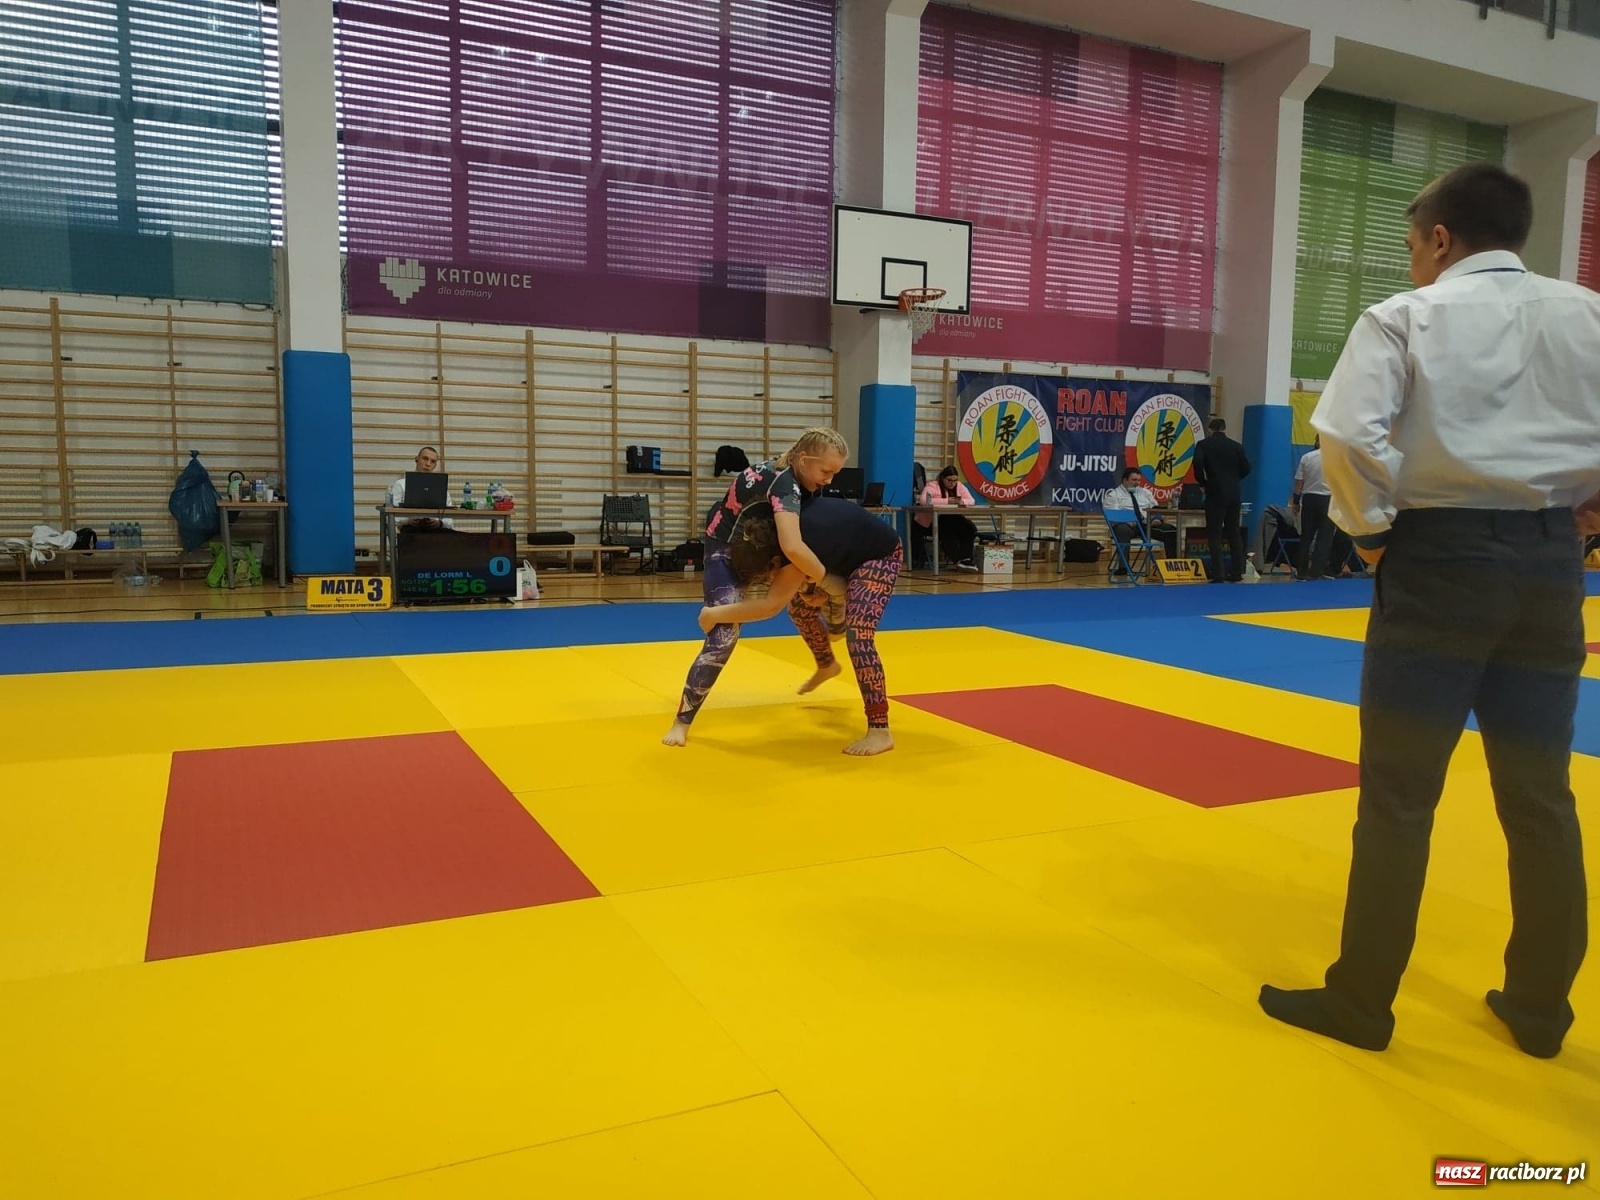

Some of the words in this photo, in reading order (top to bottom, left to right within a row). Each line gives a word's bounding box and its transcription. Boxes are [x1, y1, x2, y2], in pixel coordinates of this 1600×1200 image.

[437, 267, 532, 289] KATOWICE
[438, 287, 452, 296] dla
[453, 288, 493, 300] odmiany
[939, 314, 1004, 330] KATOWICE
[1292, 340, 1338, 353] KATOWICE
[964, 393, 993, 428] ROAN
[995, 387, 1028, 402] FIGHT
[1027, 398, 1047, 428] CLUB
[1057, 388, 1128, 416] ROAN
[1130, 402, 1155, 433] ROAN
[1156, 396, 1185, 410] FIGHT
[1185, 406, 1201, 434] CLUB
[1056, 416, 1091, 432] FIGHT
[1094, 418, 1125, 433] CLUB
[1060, 454, 1117, 472] JU-JITSU
[979, 481, 1030, 499] KATOWICE
[489, 556, 511, 577] 0
[1165, 561, 1191, 572] MATA
[1190, 560, 1203, 577] 2
[320, 579, 365, 595] MATA
[367, 578, 384, 602] 3
[430, 578, 487, 595] 1:56
